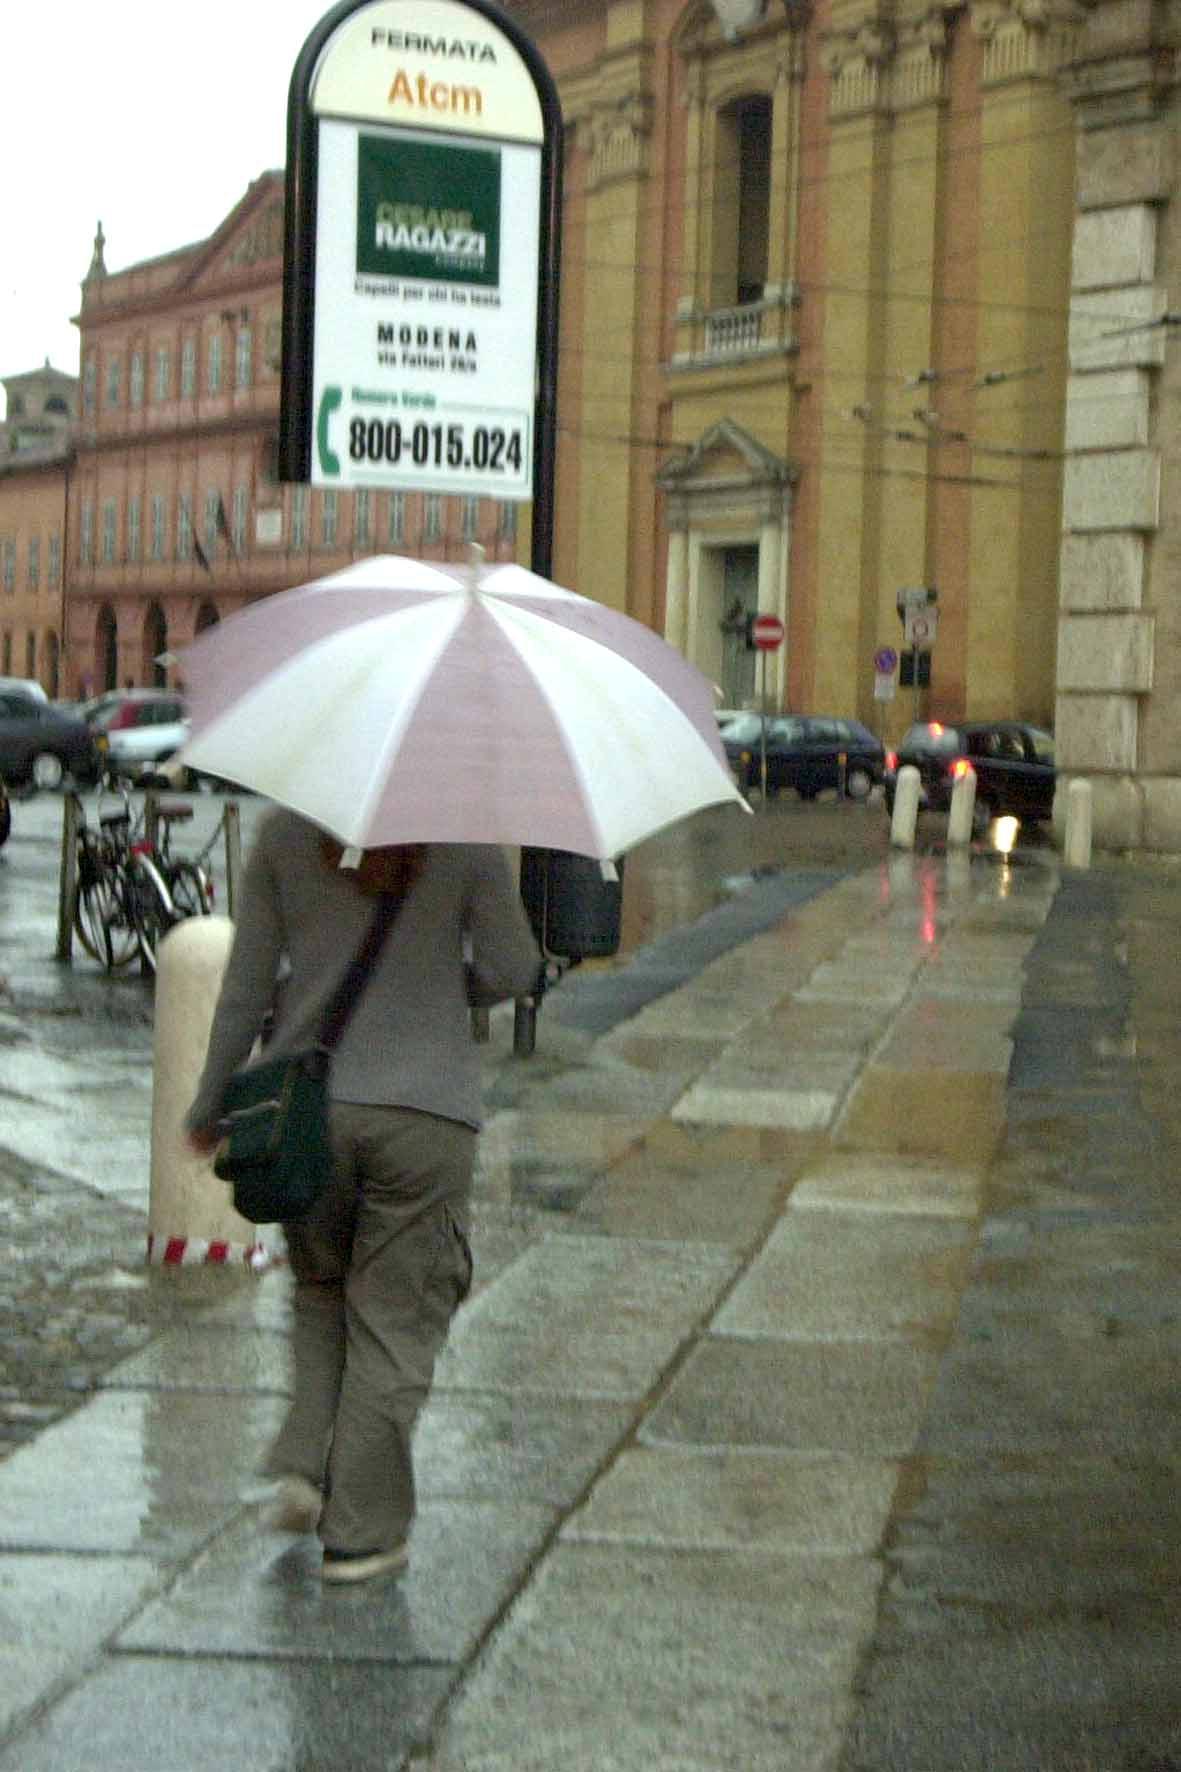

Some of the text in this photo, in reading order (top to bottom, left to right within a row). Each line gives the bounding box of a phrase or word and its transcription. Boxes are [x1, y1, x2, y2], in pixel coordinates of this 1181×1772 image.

[370, 27, 497, 64] FERMATA
[388, 68, 483, 116] Atcm
[375, 221, 486, 257] RAGAZZI
[377, 321, 477, 352] MODENA
[378, 352, 396, 367] via
[349, 415, 522, 473] 800-015.024
